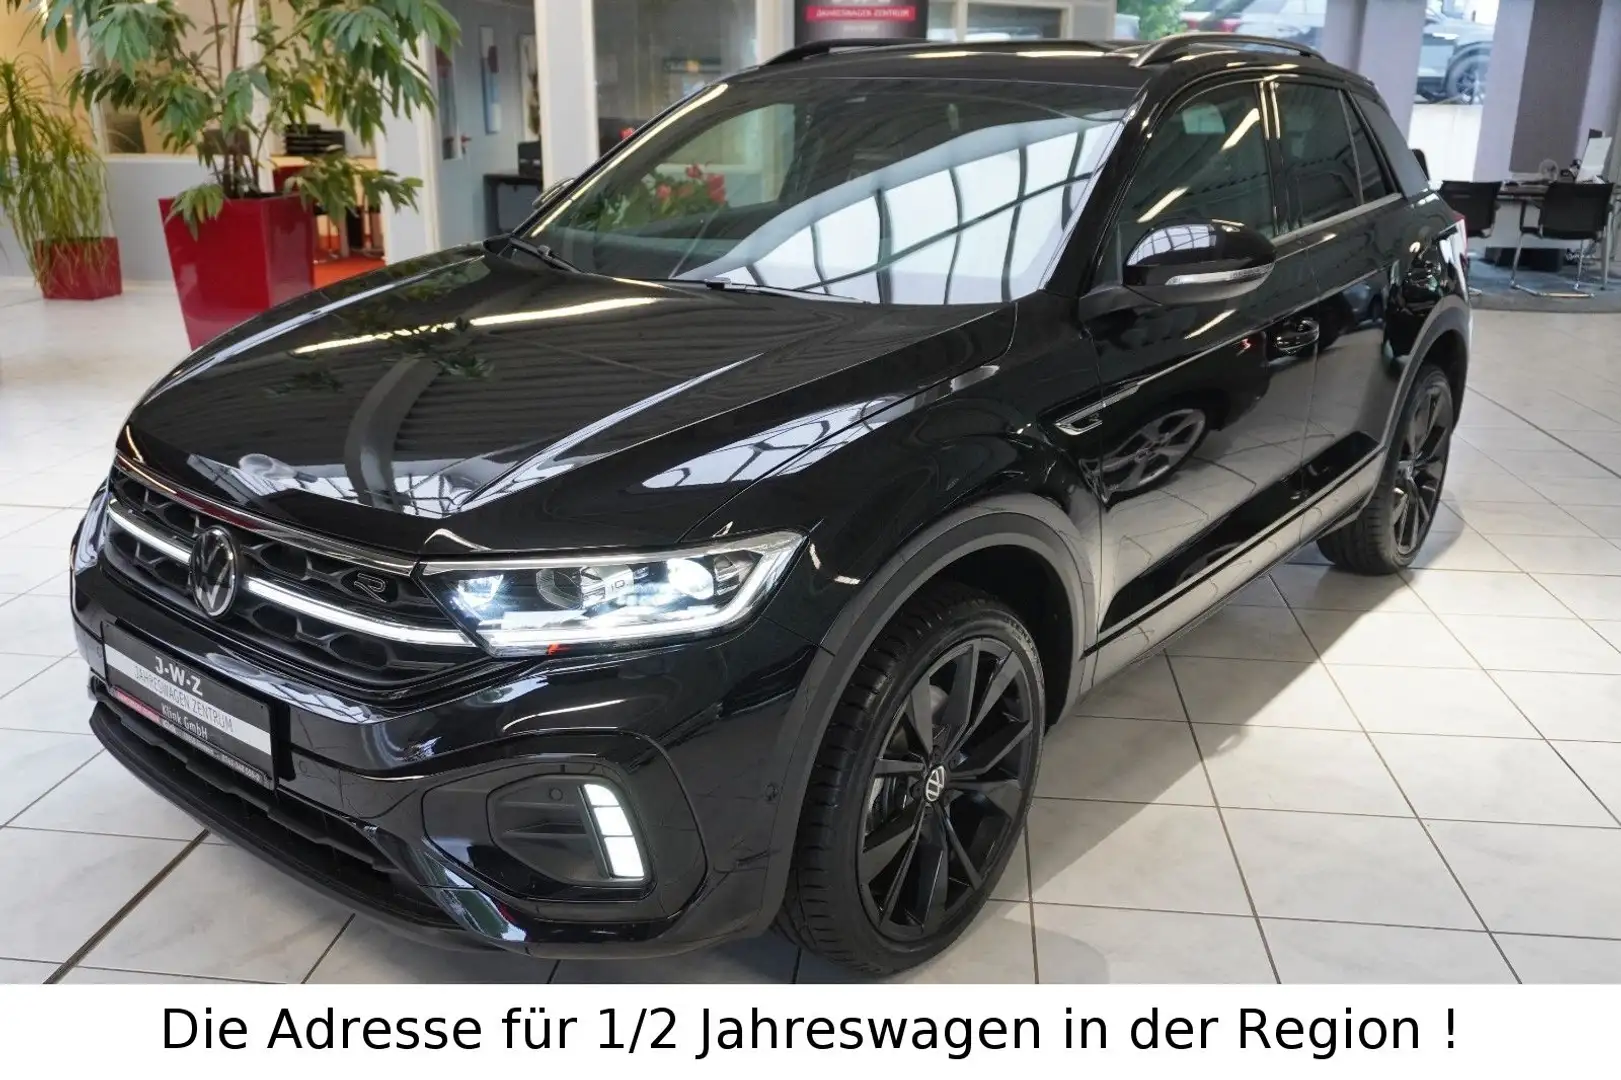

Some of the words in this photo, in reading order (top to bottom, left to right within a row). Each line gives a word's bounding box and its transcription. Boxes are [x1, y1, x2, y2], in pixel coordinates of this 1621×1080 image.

[873, 8, 911, 18] ZENTRUM
[135, 665, 191, 709] JAHRESWAGEN
[192, 698, 234, 733] ZENTRUM
[183, 716, 208, 740] GmbH
